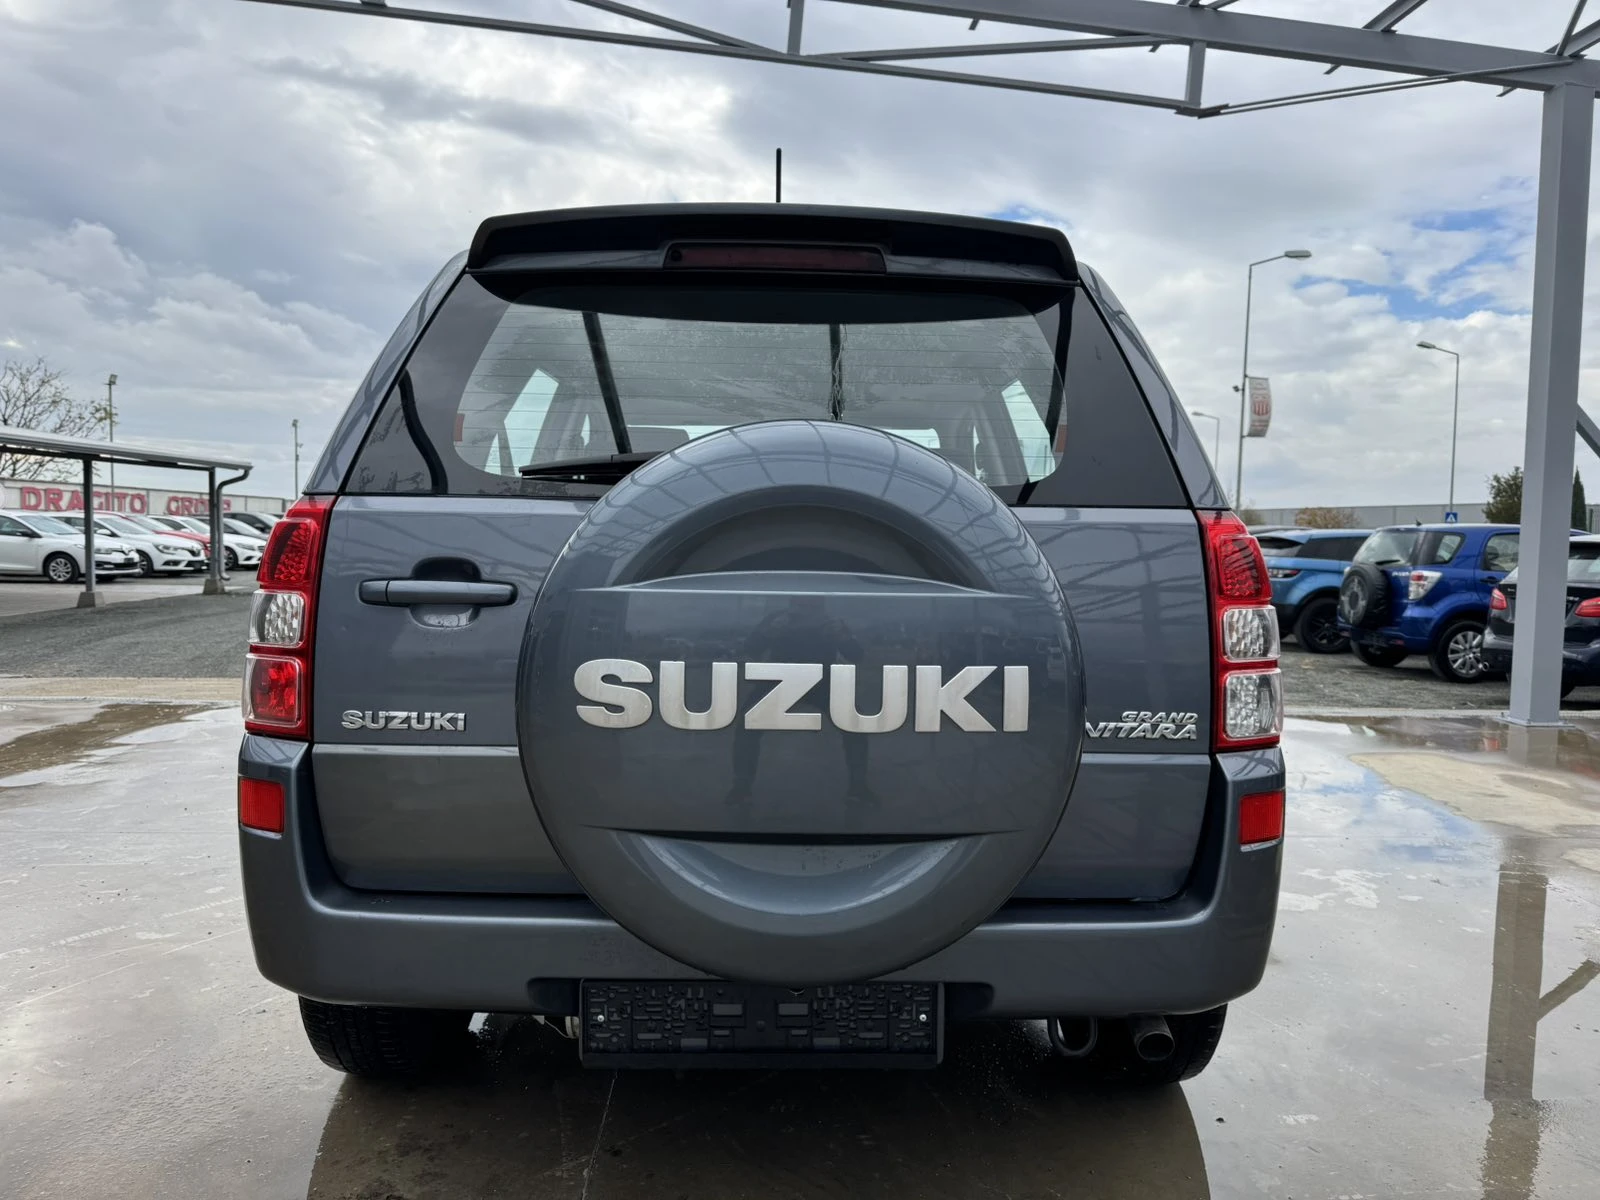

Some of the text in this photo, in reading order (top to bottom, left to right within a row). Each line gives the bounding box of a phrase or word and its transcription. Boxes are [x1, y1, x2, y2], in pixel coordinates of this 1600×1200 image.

[166, 495, 232, 516] GROP
[574, 658, 1029, 733] SUZUKI
[341, 709, 466, 732] SUZUKI
[1121, 711, 1199, 724] GRAND
[1085, 721, 1197, 740] VITARA
